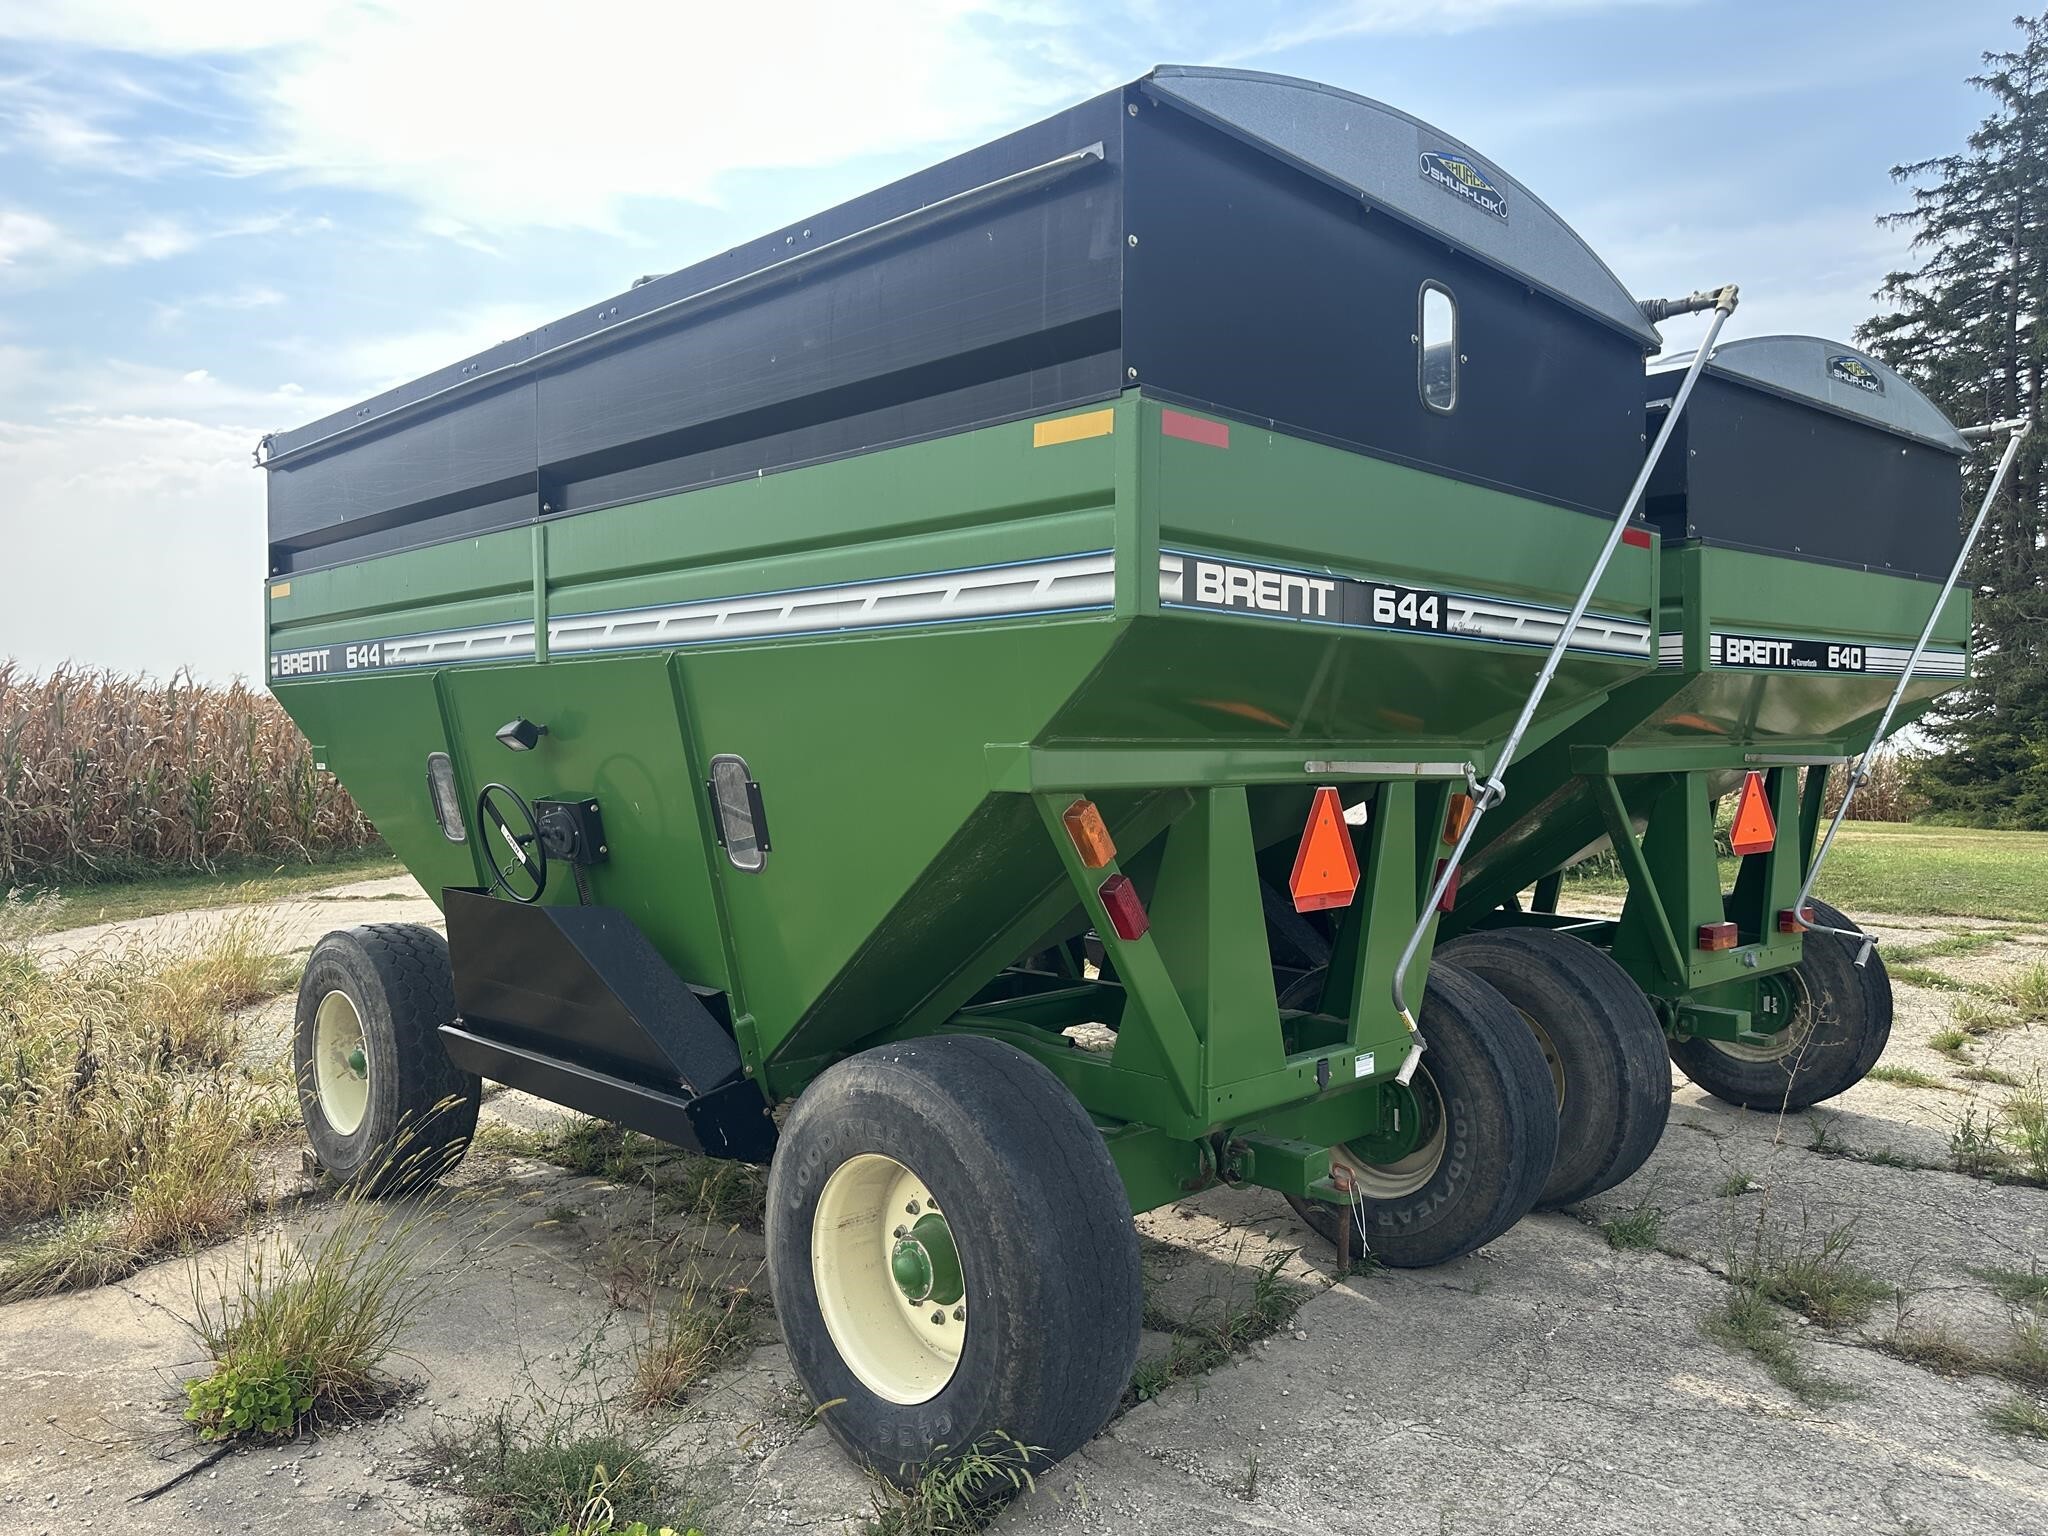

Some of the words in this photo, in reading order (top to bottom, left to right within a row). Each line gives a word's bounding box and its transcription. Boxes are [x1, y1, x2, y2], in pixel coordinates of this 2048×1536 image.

[1430, 167, 1499, 214] SHUR-LOK
[1833, 369, 1879, 392] SHUR-LOK
[1196, 561, 1335, 616] BRENT
[1373, 588, 1439, 629] 644
[282, 650, 330, 675] BRENT
[346, 643, 380, 669] 644
[1726, 638, 1793, 666] BRENT
[1828, 645, 1861, 669] 640
[506, 834, 519, 853] OPEN
[1377, 1098, 1467, 1226] GOODYEAR
